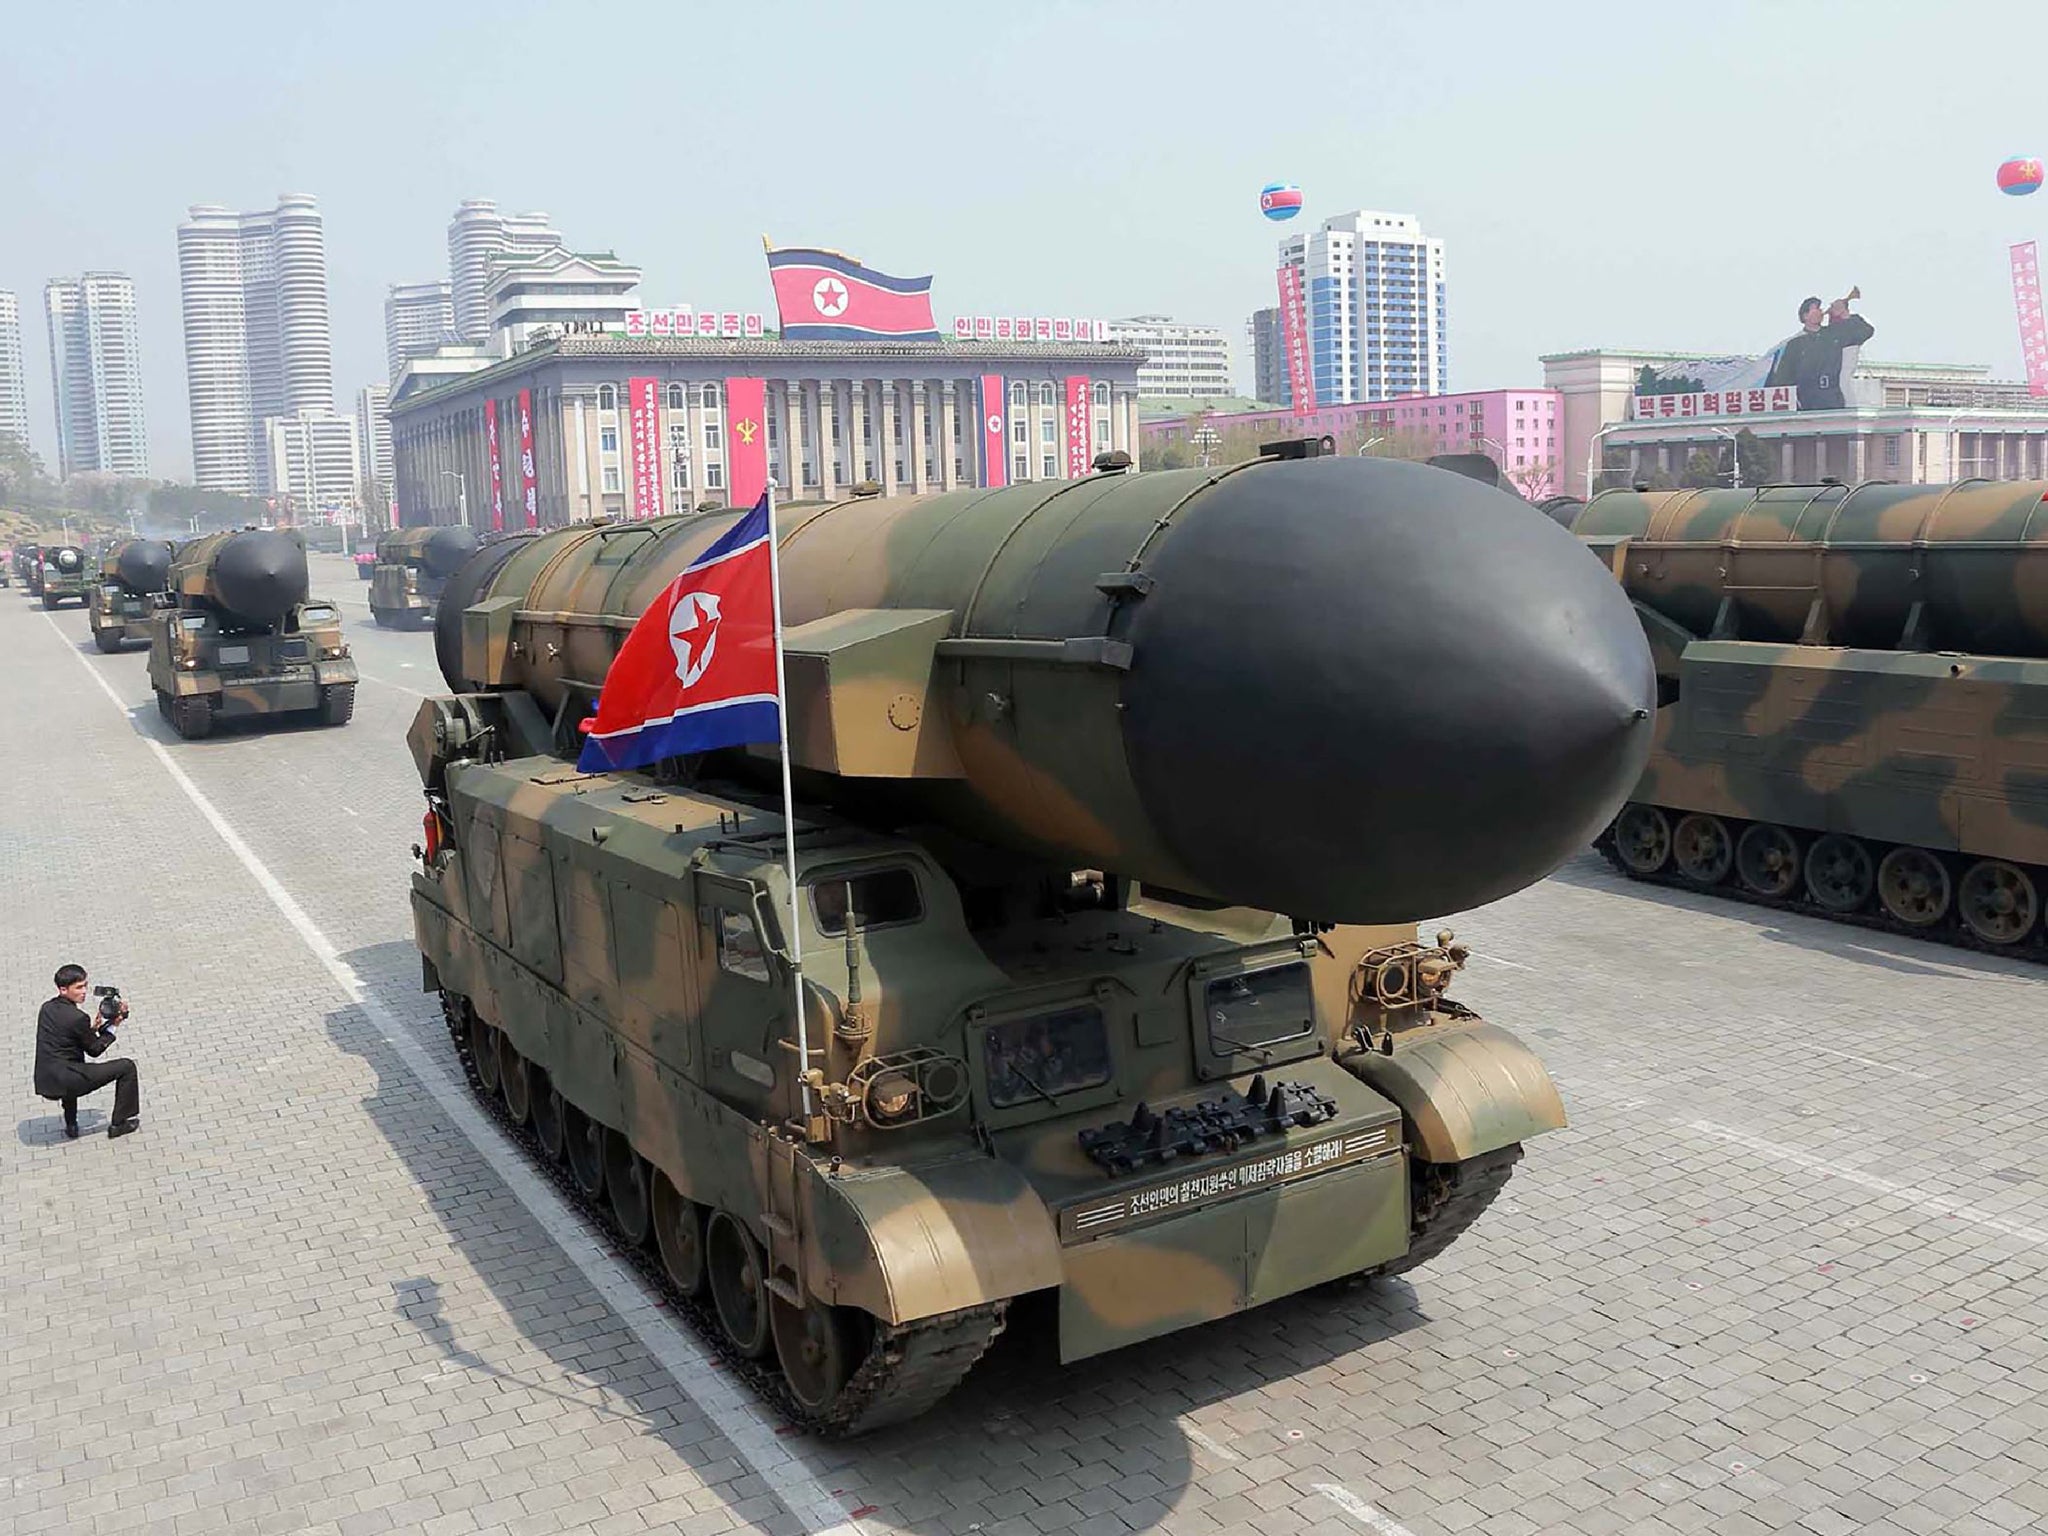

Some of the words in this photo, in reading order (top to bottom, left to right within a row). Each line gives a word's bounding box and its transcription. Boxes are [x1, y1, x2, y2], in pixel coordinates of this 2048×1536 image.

[627, 313, 763, 335] 조선민주주의
[1129, 1184, 1179, 1216] 조선인민의
[1239, 1150, 1303, 1186] 미제침략자들을
[1303, 1140, 1343, 1168] 소멸하라!
